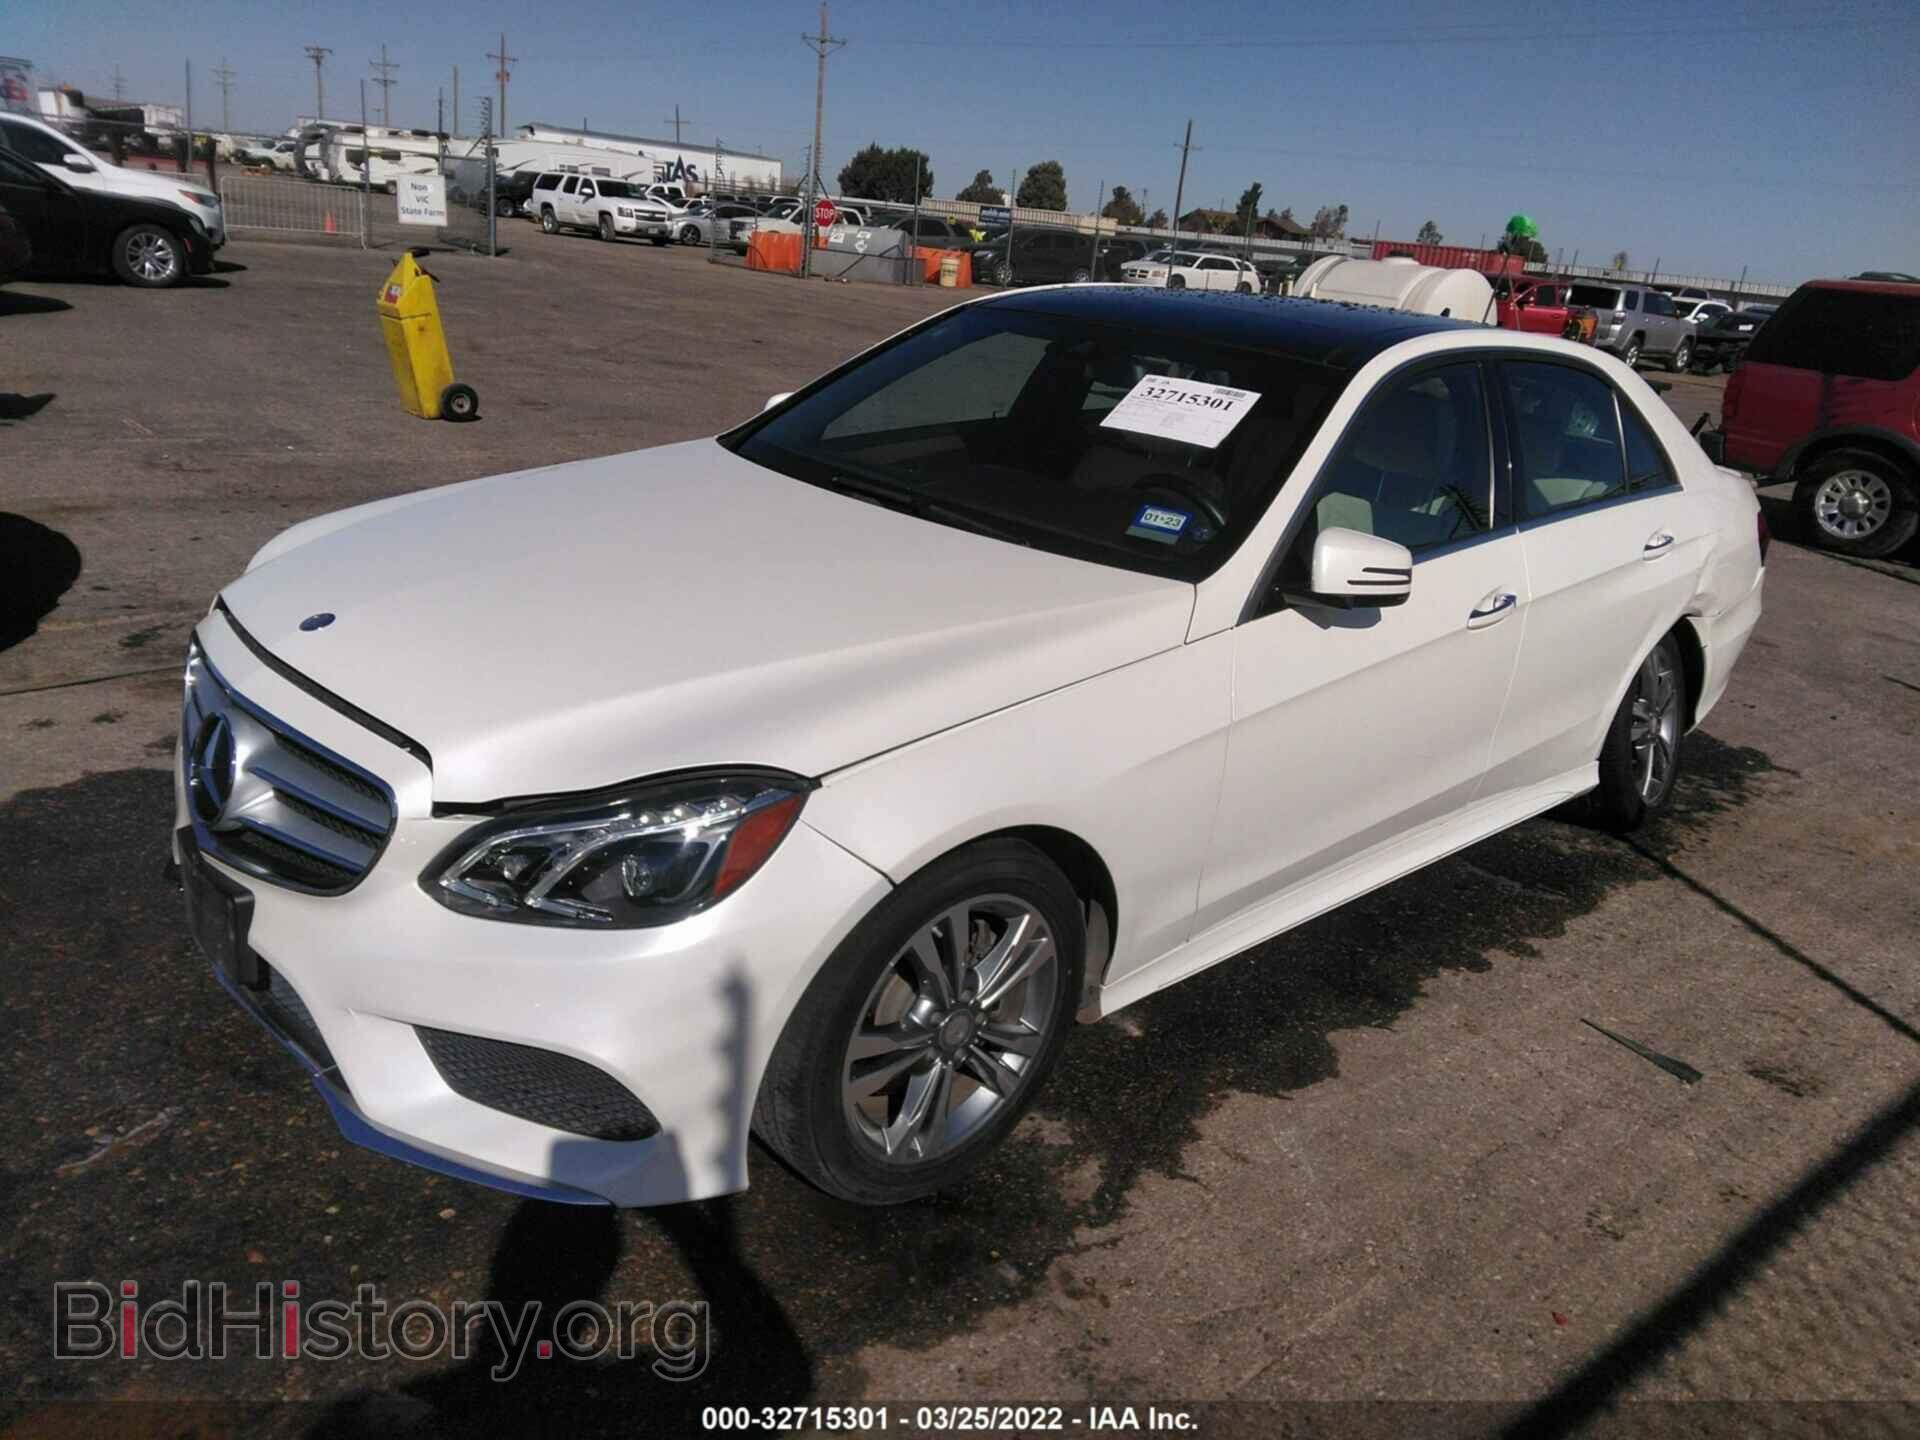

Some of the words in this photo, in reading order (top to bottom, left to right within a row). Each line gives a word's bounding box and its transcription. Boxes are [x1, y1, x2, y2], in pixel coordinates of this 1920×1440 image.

[411, 183, 428, 191] Non
[415, 195, 429, 204] VIC
[401, 206, 421, 215] State
[424, 208, 444, 216] Farm
[815, 207, 834, 219] STOP
[1139, 387, 1235, 411] 32715301
